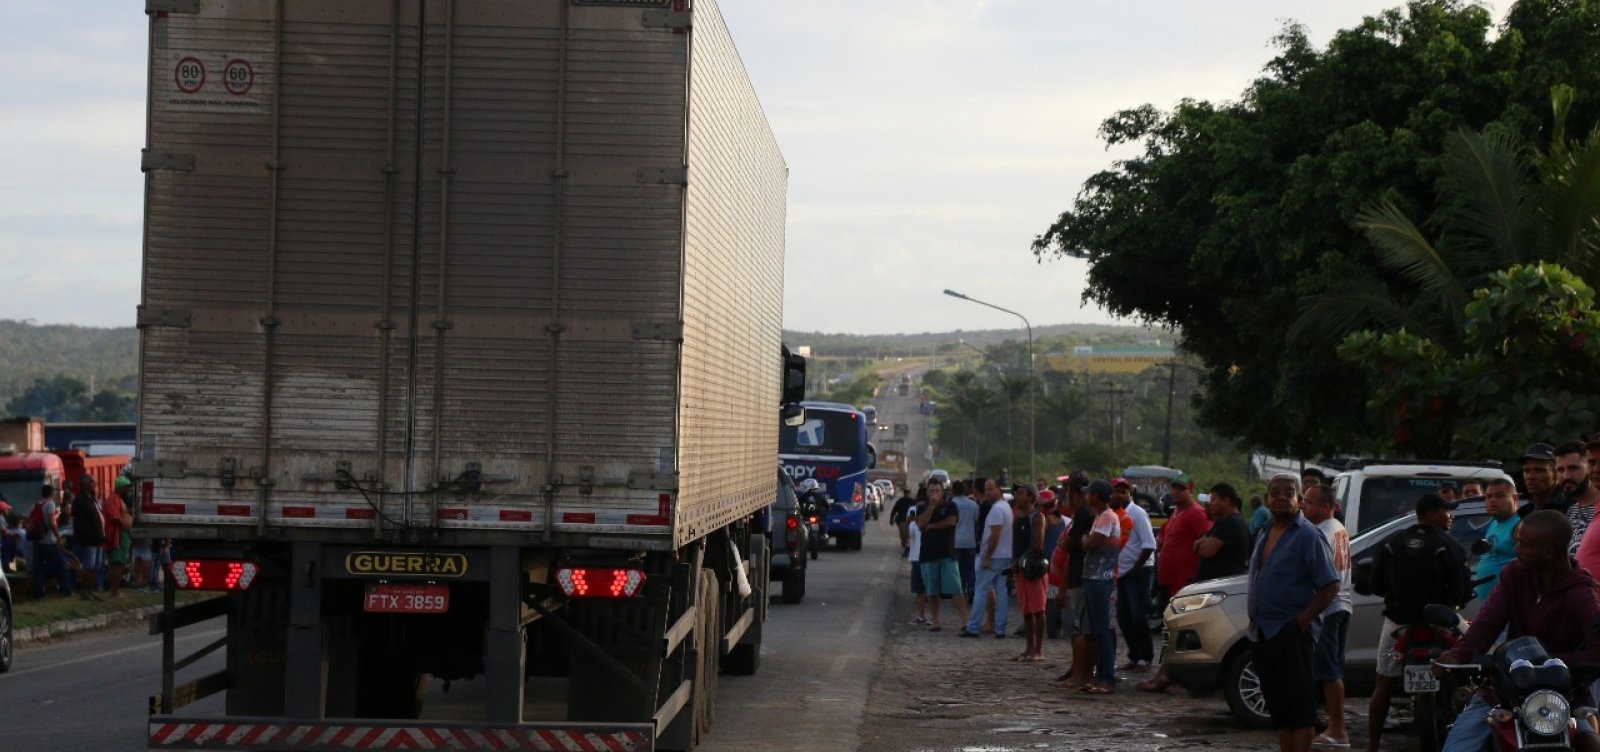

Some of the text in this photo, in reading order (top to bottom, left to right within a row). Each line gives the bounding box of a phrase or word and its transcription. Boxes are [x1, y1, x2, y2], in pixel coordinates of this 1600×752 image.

[182, 65, 198, 79] 80
[229, 67, 246, 81] 60
[354, 555, 458, 573] GUERRA
[369, 594, 445, 610] FTX 3859
[1408, 680, 1436, 690] 7926
